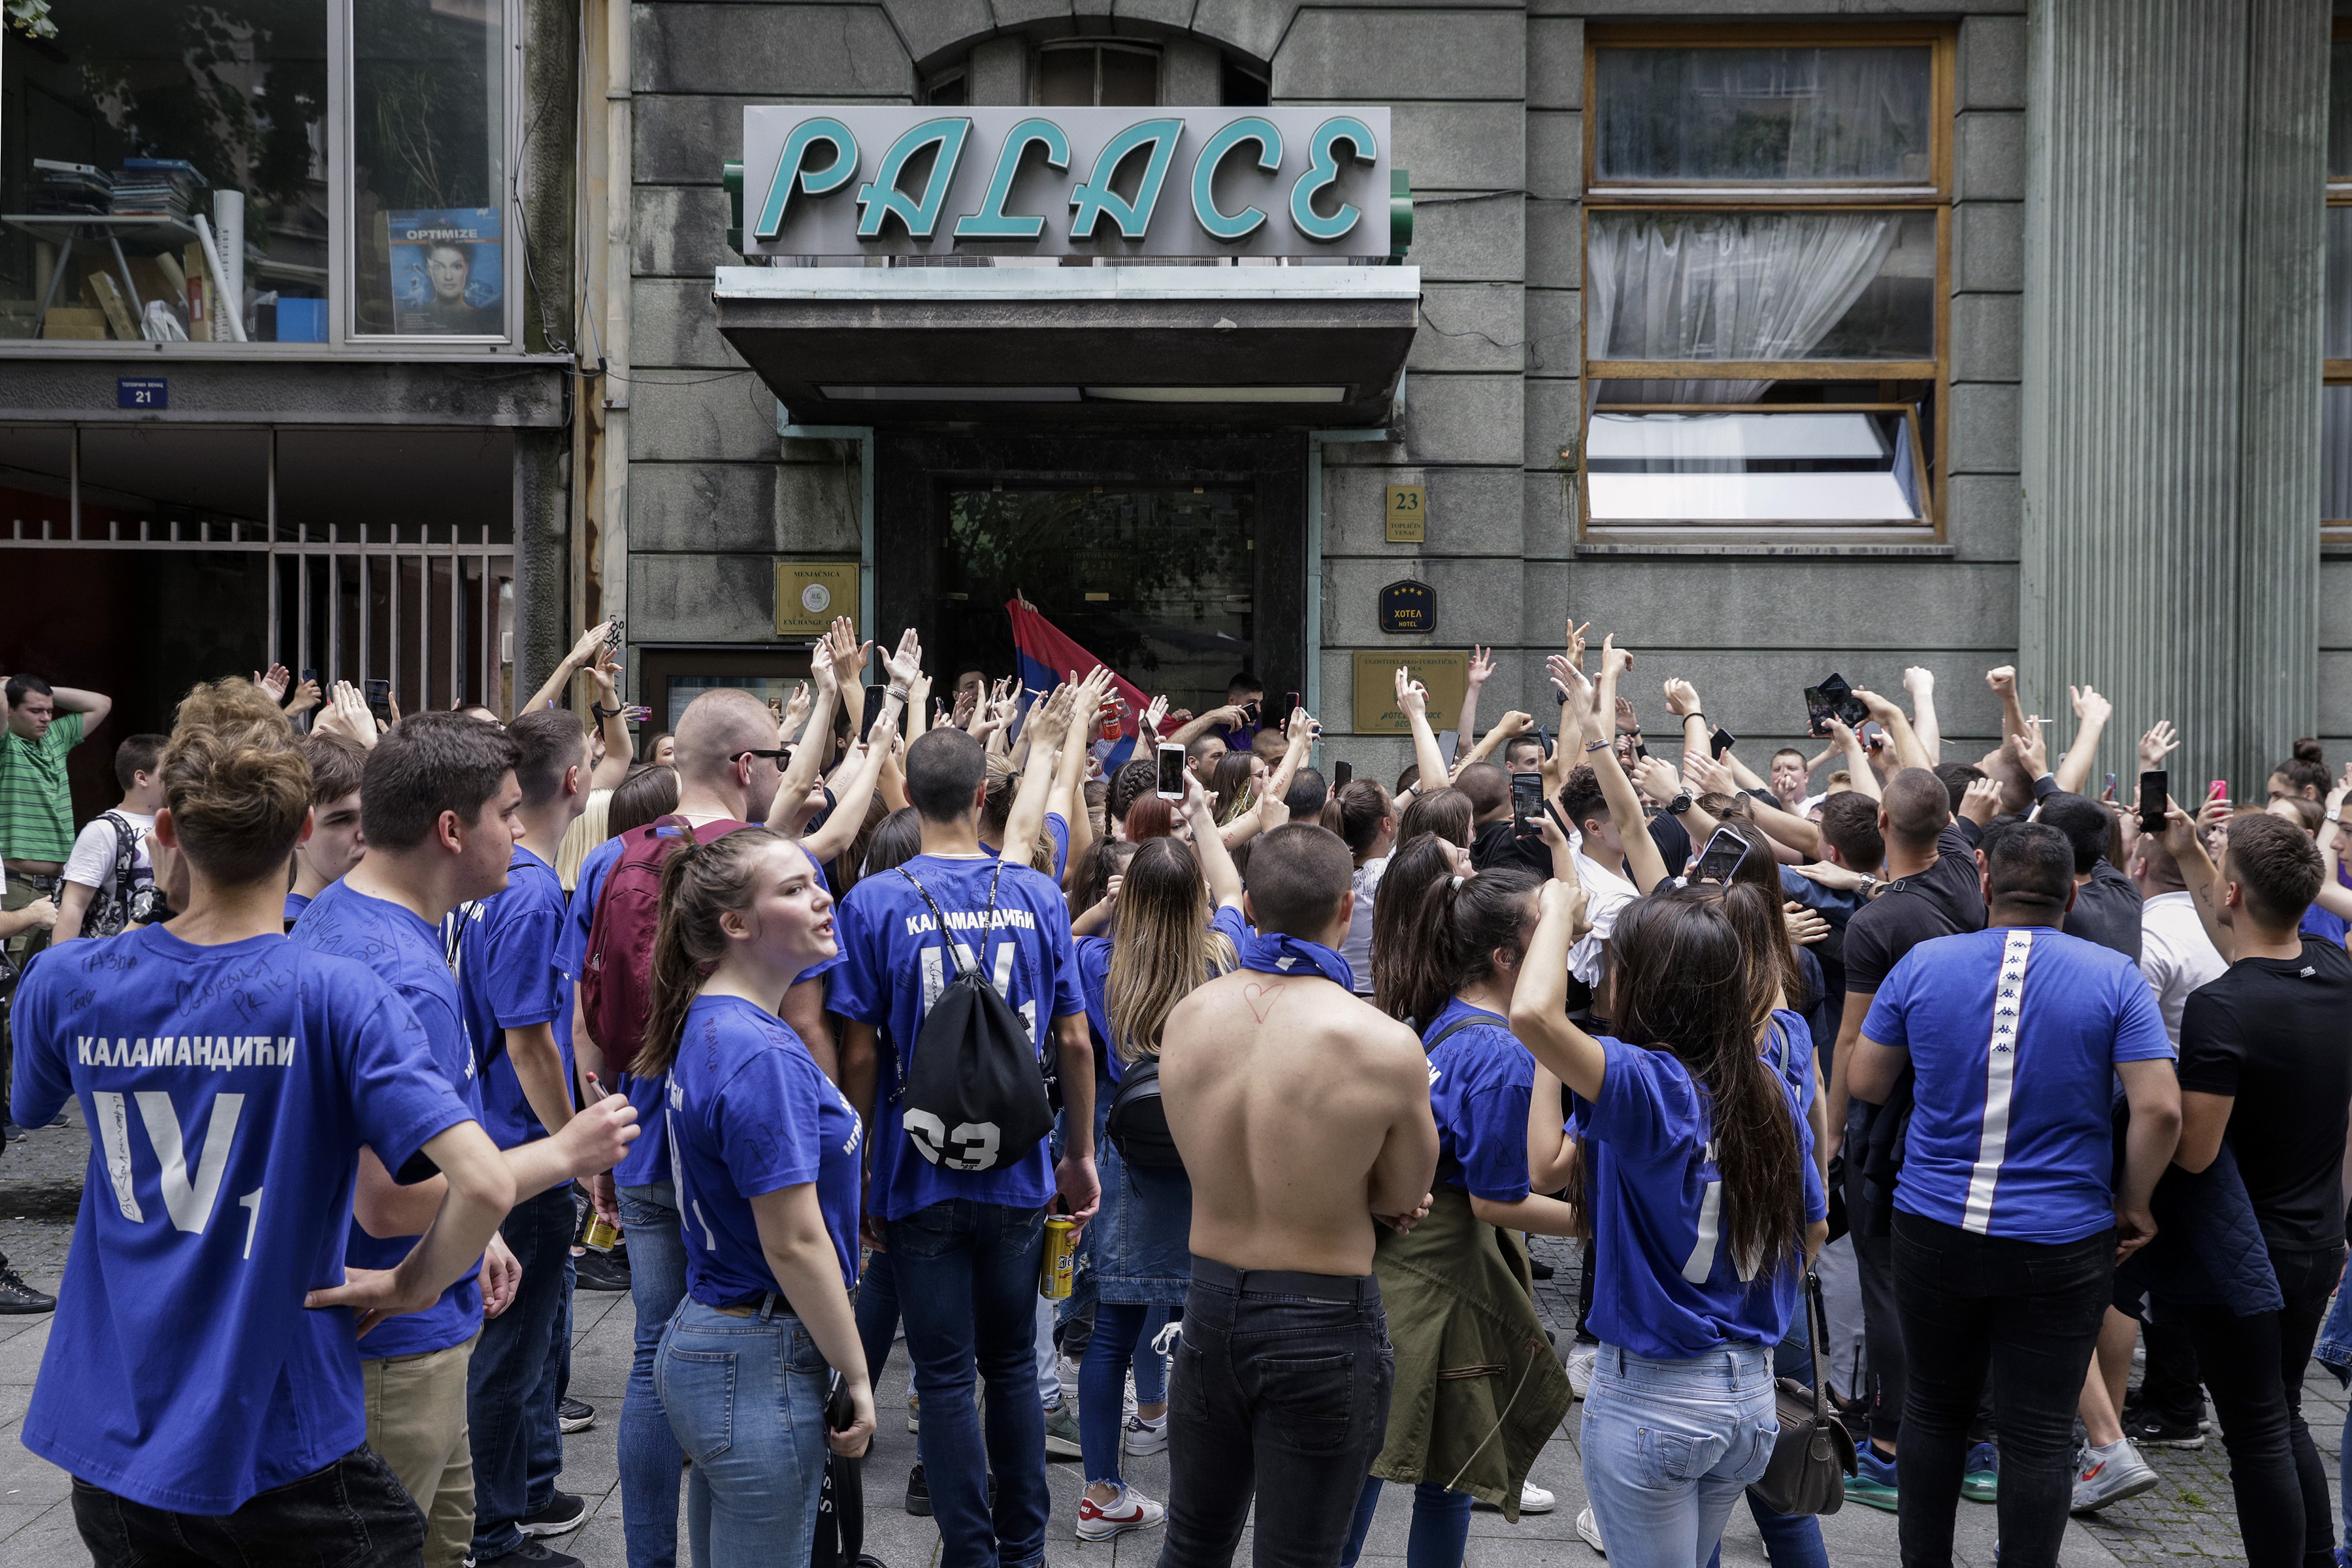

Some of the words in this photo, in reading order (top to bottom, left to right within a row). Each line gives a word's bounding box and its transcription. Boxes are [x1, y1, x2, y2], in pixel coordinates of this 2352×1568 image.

[753, 116, 1379, 243] PALACE
[406, 229, 478, 240] OPTIMIZE
[135, 390, 151, 402] 21
[1396, 493, 1418, 510] 23
[906, 909, 1036, 936] КАЛАМАНДИЋИ
[78, 1036, 295, 1071] КАЛАМАНДИЋИ
[92, 1091, 245, 1235] IV
[239, 1186, 263, 1260] 1
[1081, 1505, 1092, 1514] NIKE
